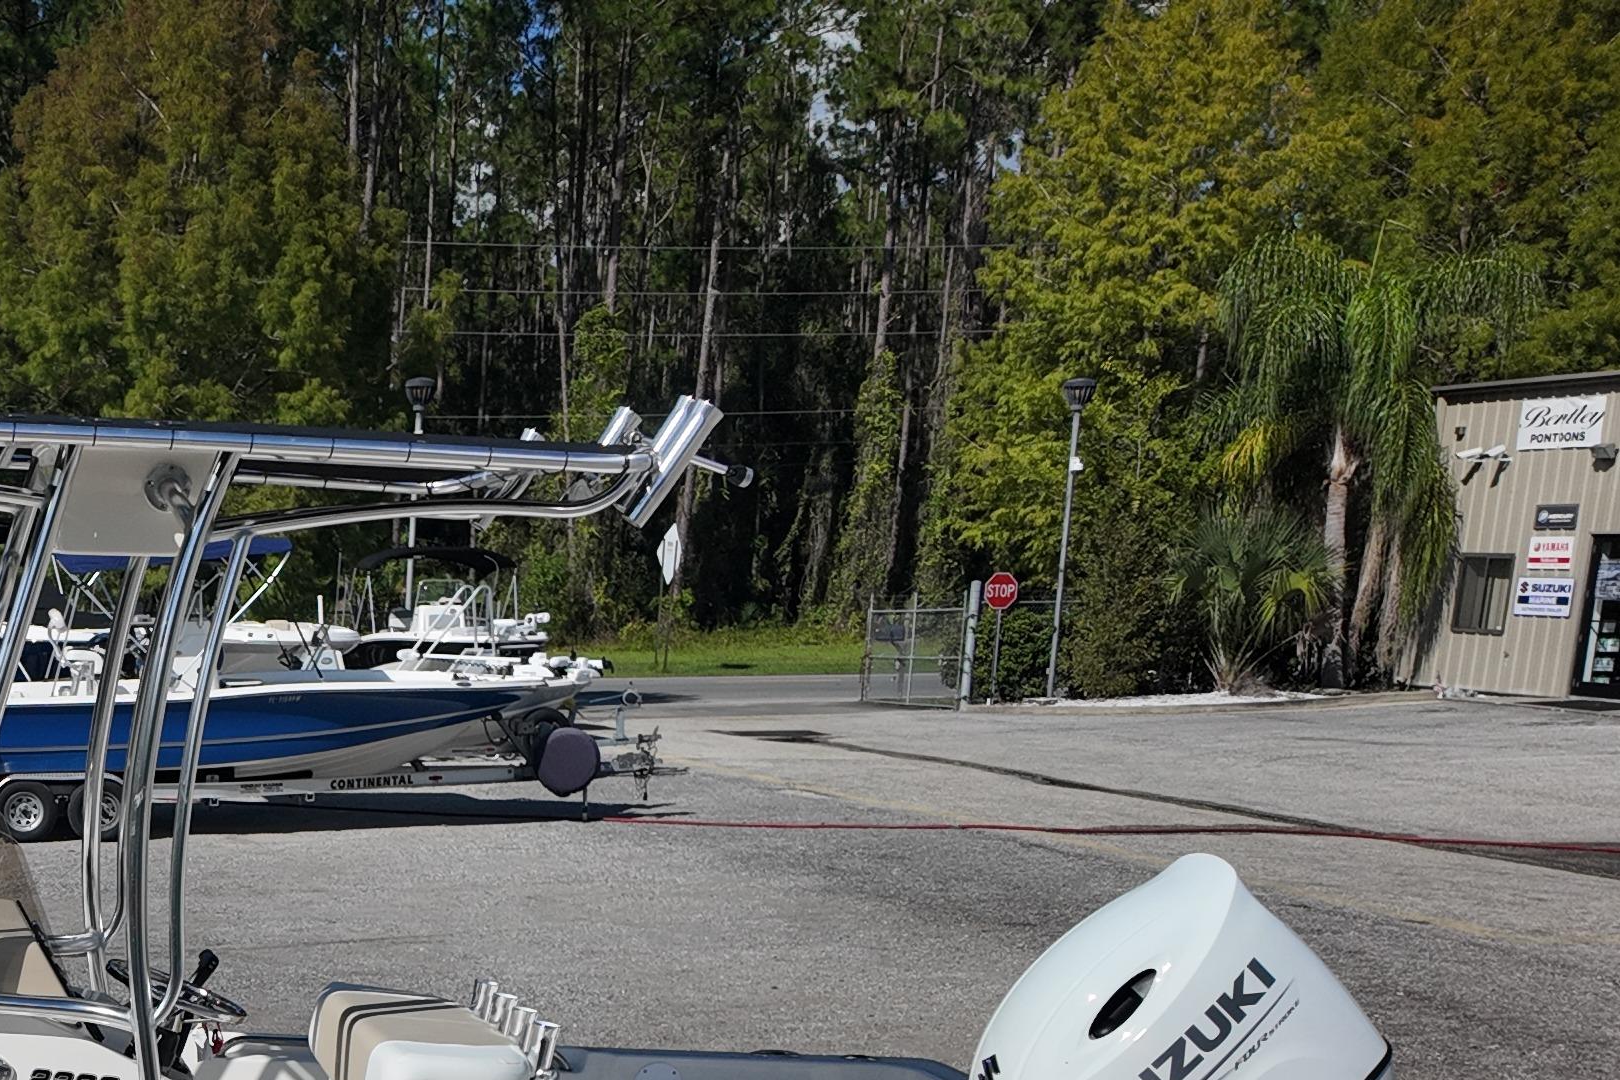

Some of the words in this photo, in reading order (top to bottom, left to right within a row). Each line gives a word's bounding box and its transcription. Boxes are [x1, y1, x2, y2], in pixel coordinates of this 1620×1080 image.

[1524, 404, 1605, 430] Bentley
[1530, 431, 1586, 443] PONTOONS
[1542, 542, 1569, 551] YAMAHA
[986, 584, 1016, 598] STOP
[1531, 583, 1572, 593] SUZUKI
[330, 774, 414, 790] CONTINENTAL
